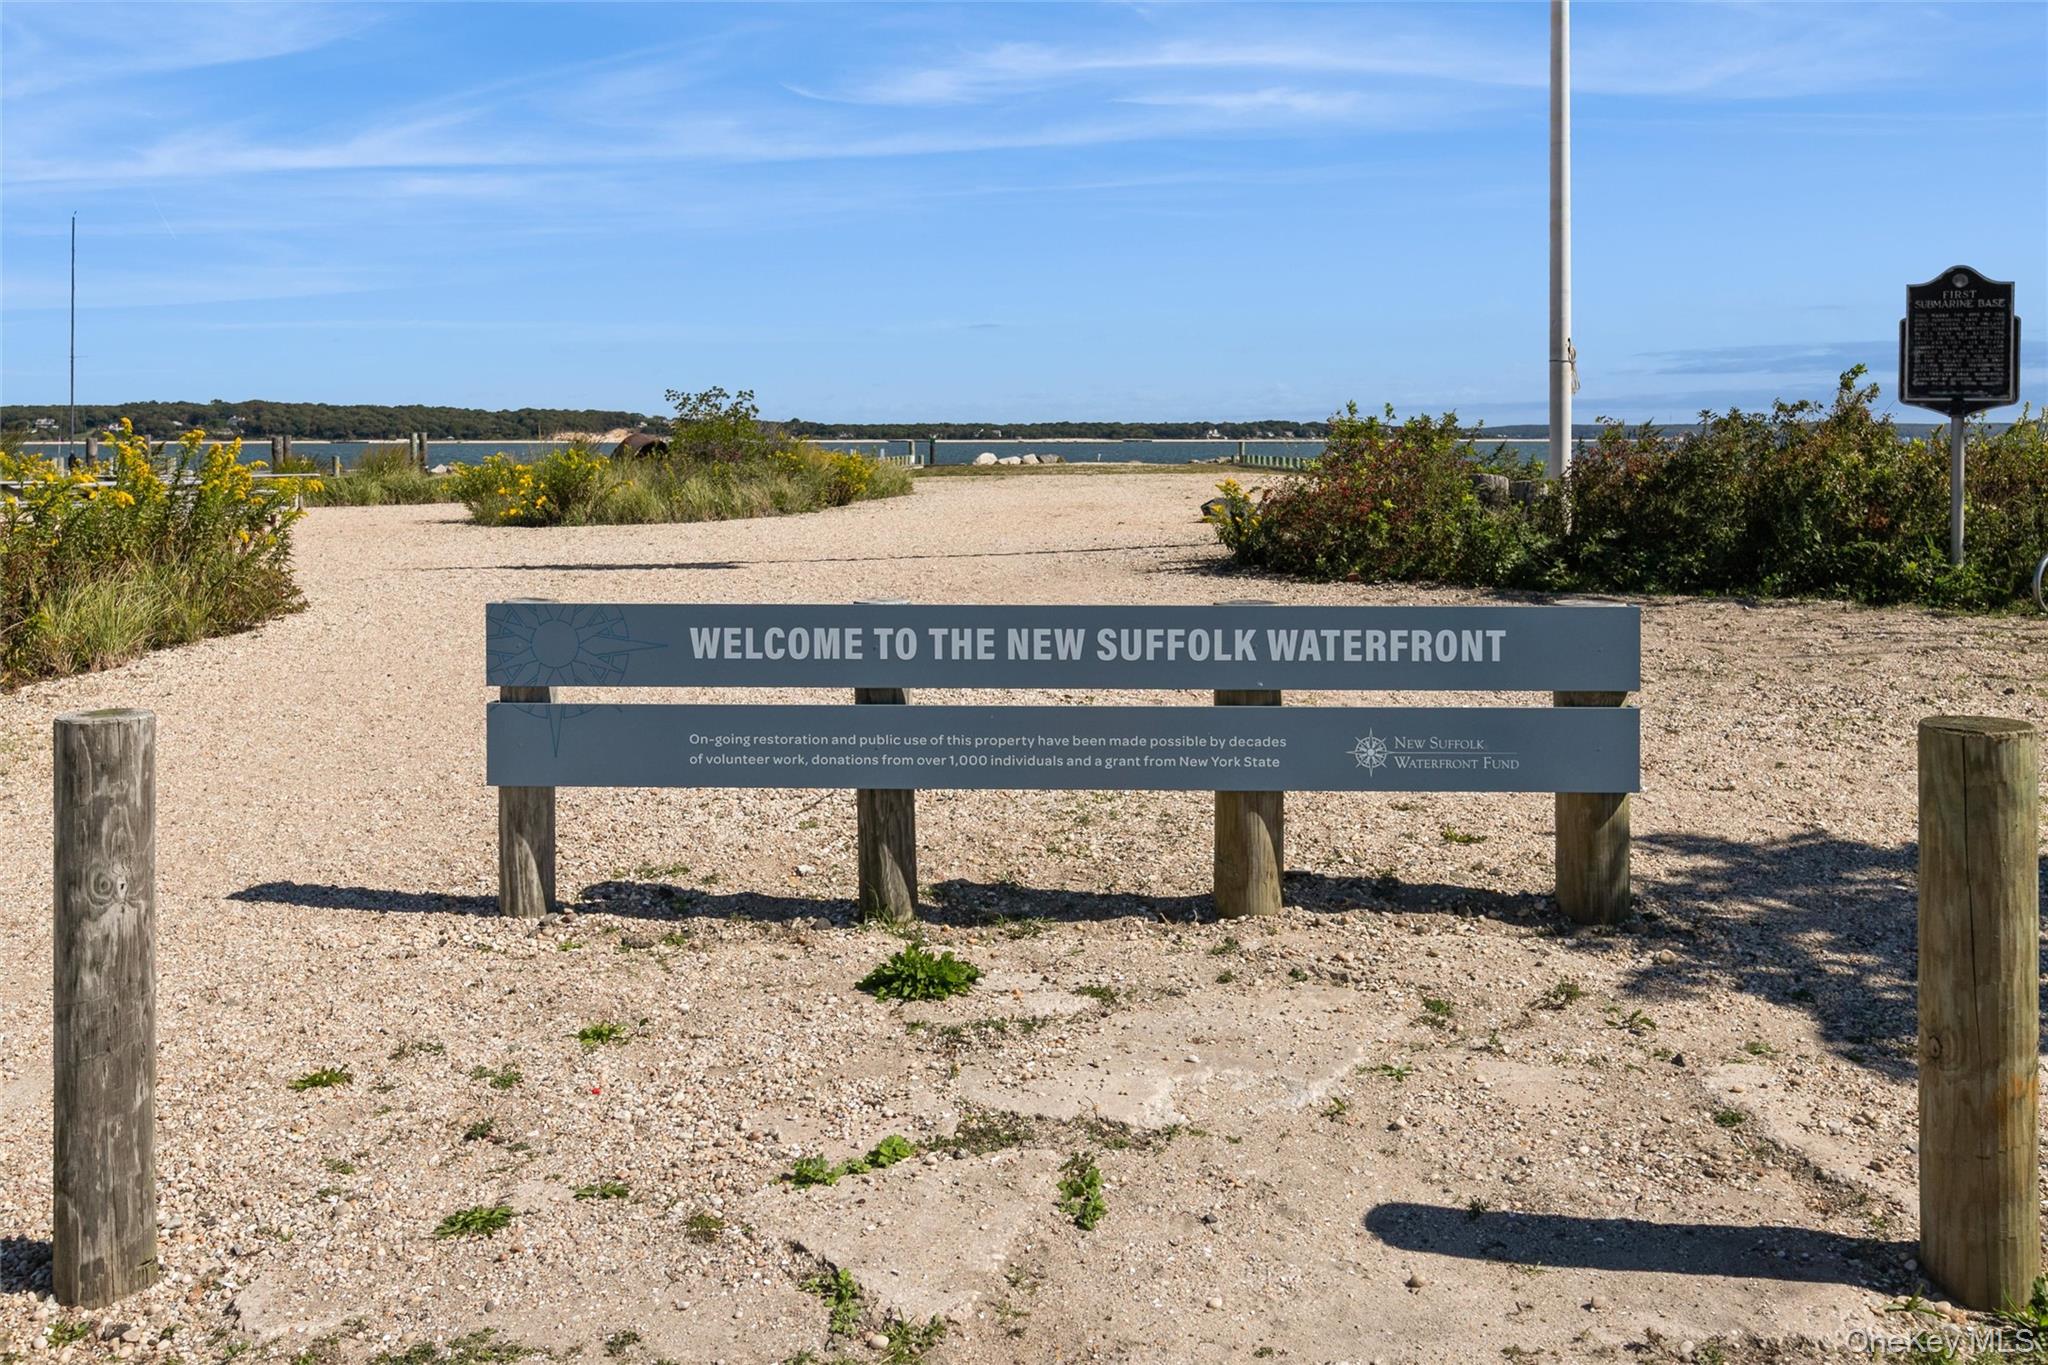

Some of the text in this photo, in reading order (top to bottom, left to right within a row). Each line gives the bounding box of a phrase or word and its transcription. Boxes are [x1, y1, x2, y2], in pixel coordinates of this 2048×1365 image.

[1943, 290, 1977, 299] FIRST
[1914, 299, 2006, 309] SUBMARINE BASE
[690, 627, 1506, 662] WELCOME TO THE NEW SUFFOLK WATERFRONT
[689, 733, 1286, 749] On-going restoration and public use of this property have been made possible by decades
[690, 753, 1280, 769] of volunteer work, donations from over 1,000 individuals and a grant from New York State
